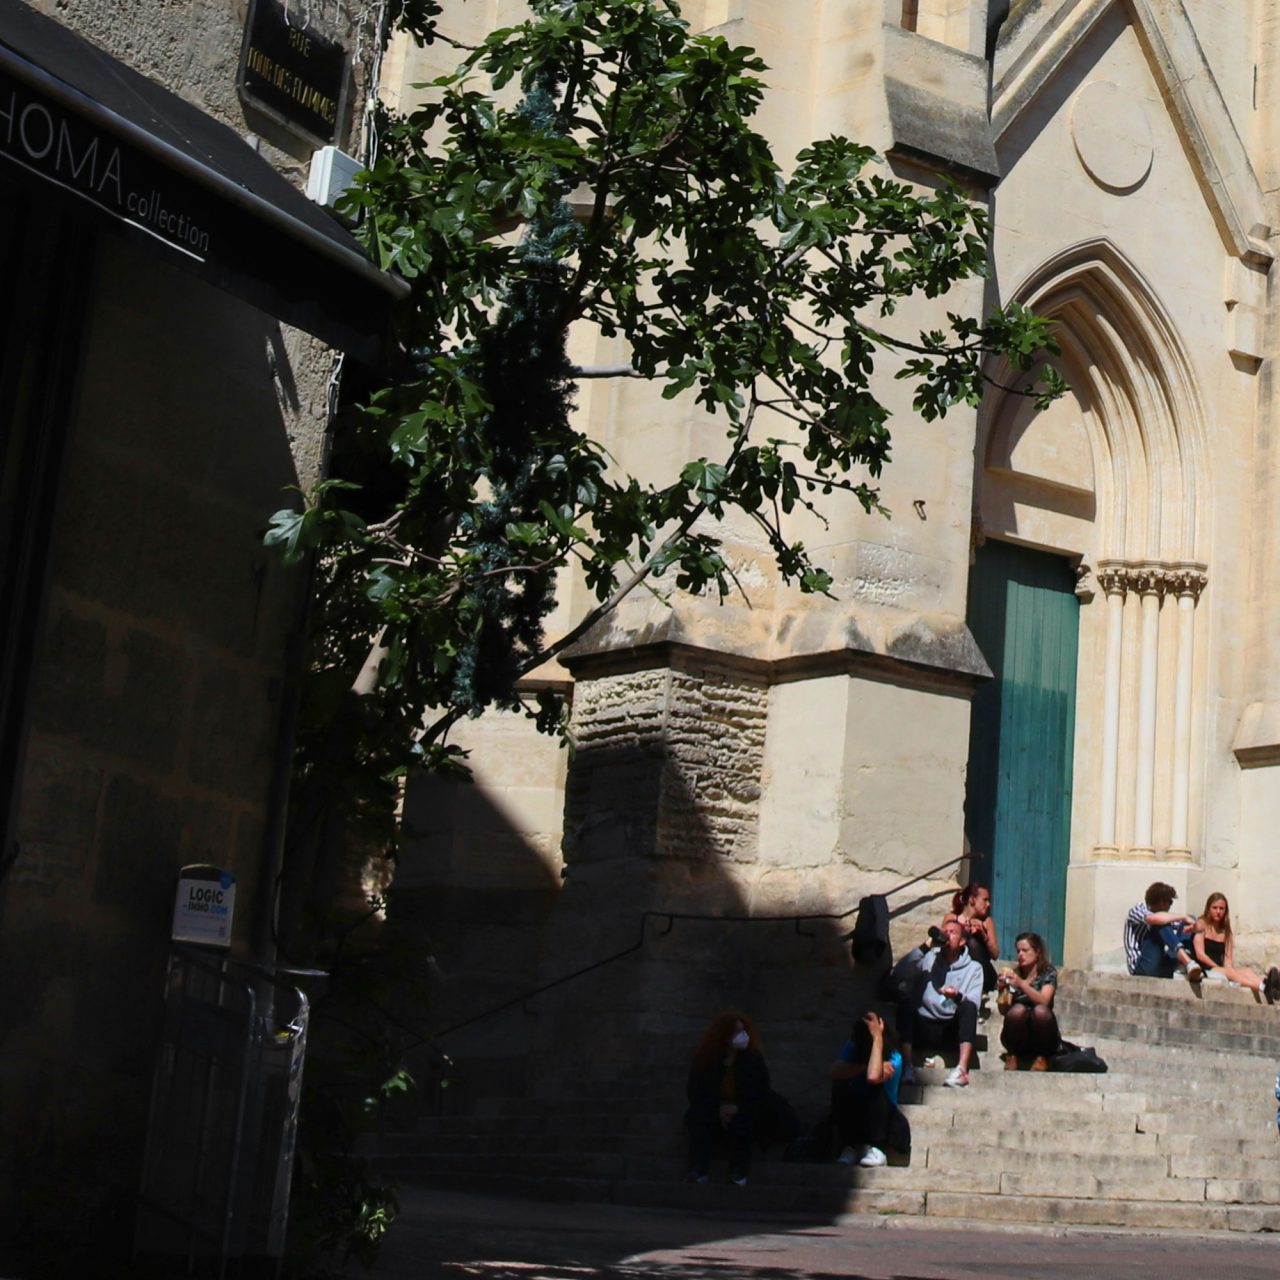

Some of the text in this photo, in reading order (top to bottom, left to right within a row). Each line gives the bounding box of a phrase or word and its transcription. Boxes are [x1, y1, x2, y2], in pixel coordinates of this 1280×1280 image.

[288, 27, 312, 58] RUE
[273, 63, 292, 94] DES
[291, 76, 336, 125] FLAMMES
[126, 186, 211, 252] collection
[190, 887, 224, 904] LOGIC
